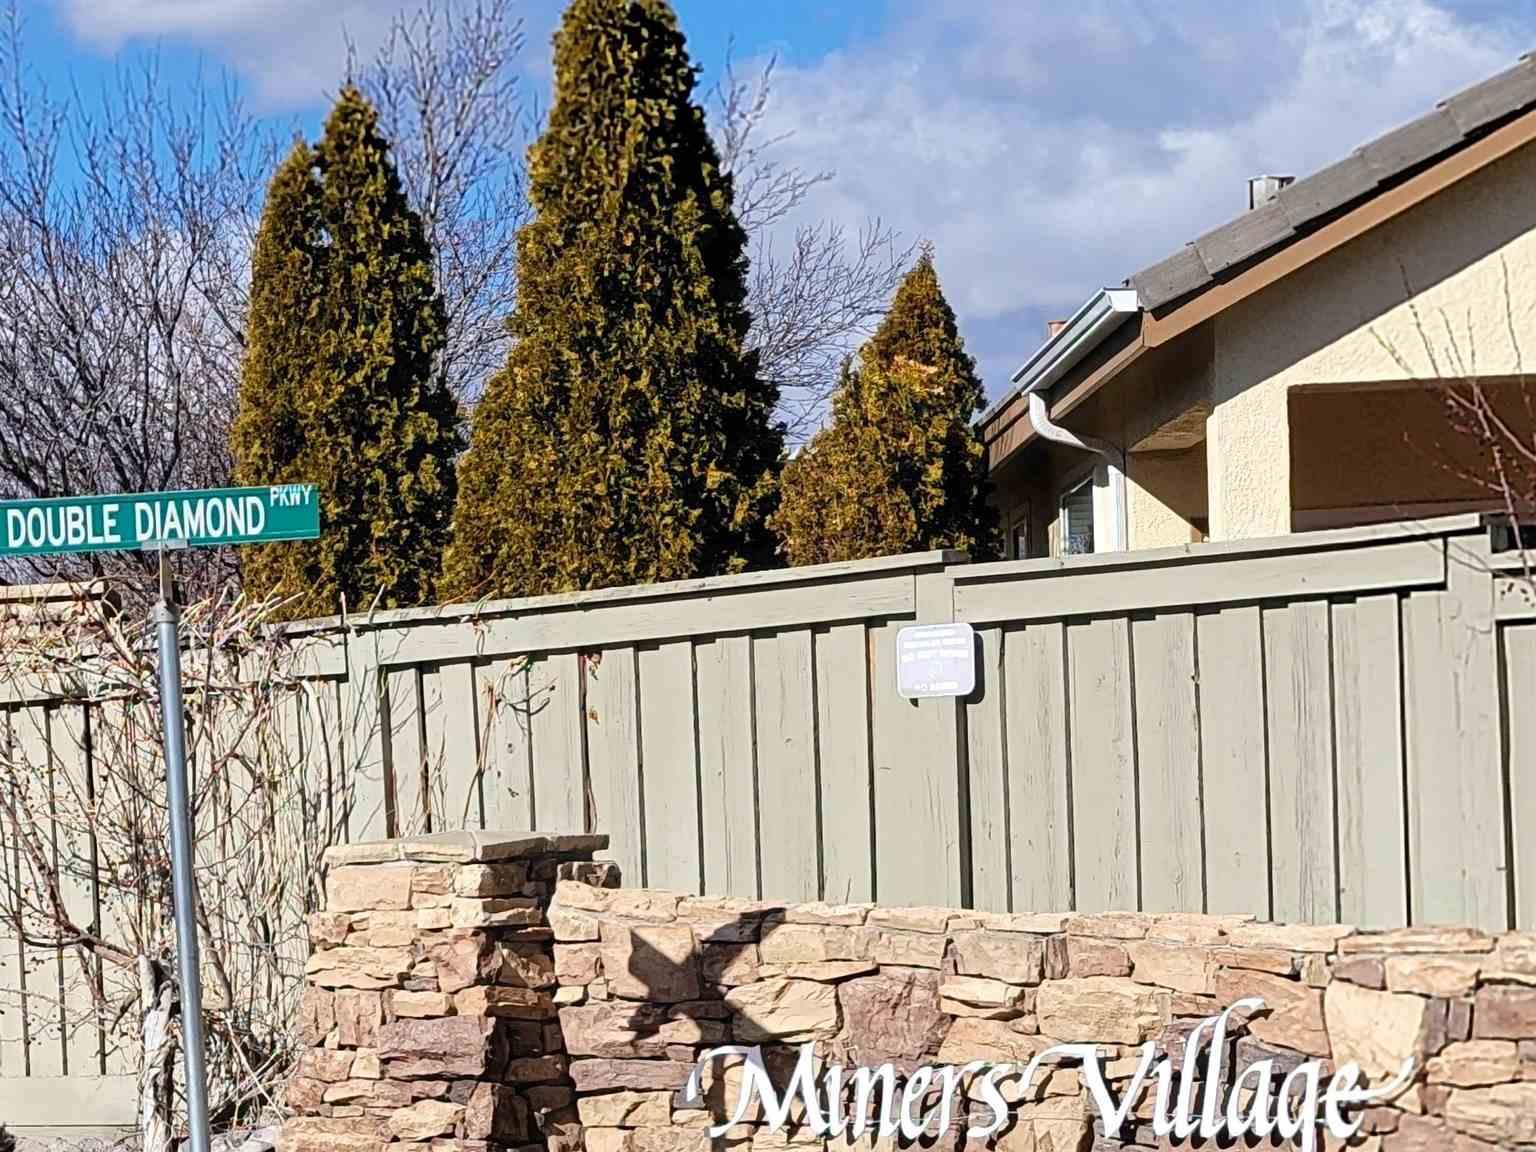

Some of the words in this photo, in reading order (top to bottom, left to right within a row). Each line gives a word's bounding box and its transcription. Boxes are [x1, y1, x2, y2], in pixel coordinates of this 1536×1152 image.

[7, 504, 121, 548] DOUBLE
[135, 496, 265, 541] DIAMOND
[270, 485, 312, 507] PKWY
[686, 1041, 1019, 1138] Miners
